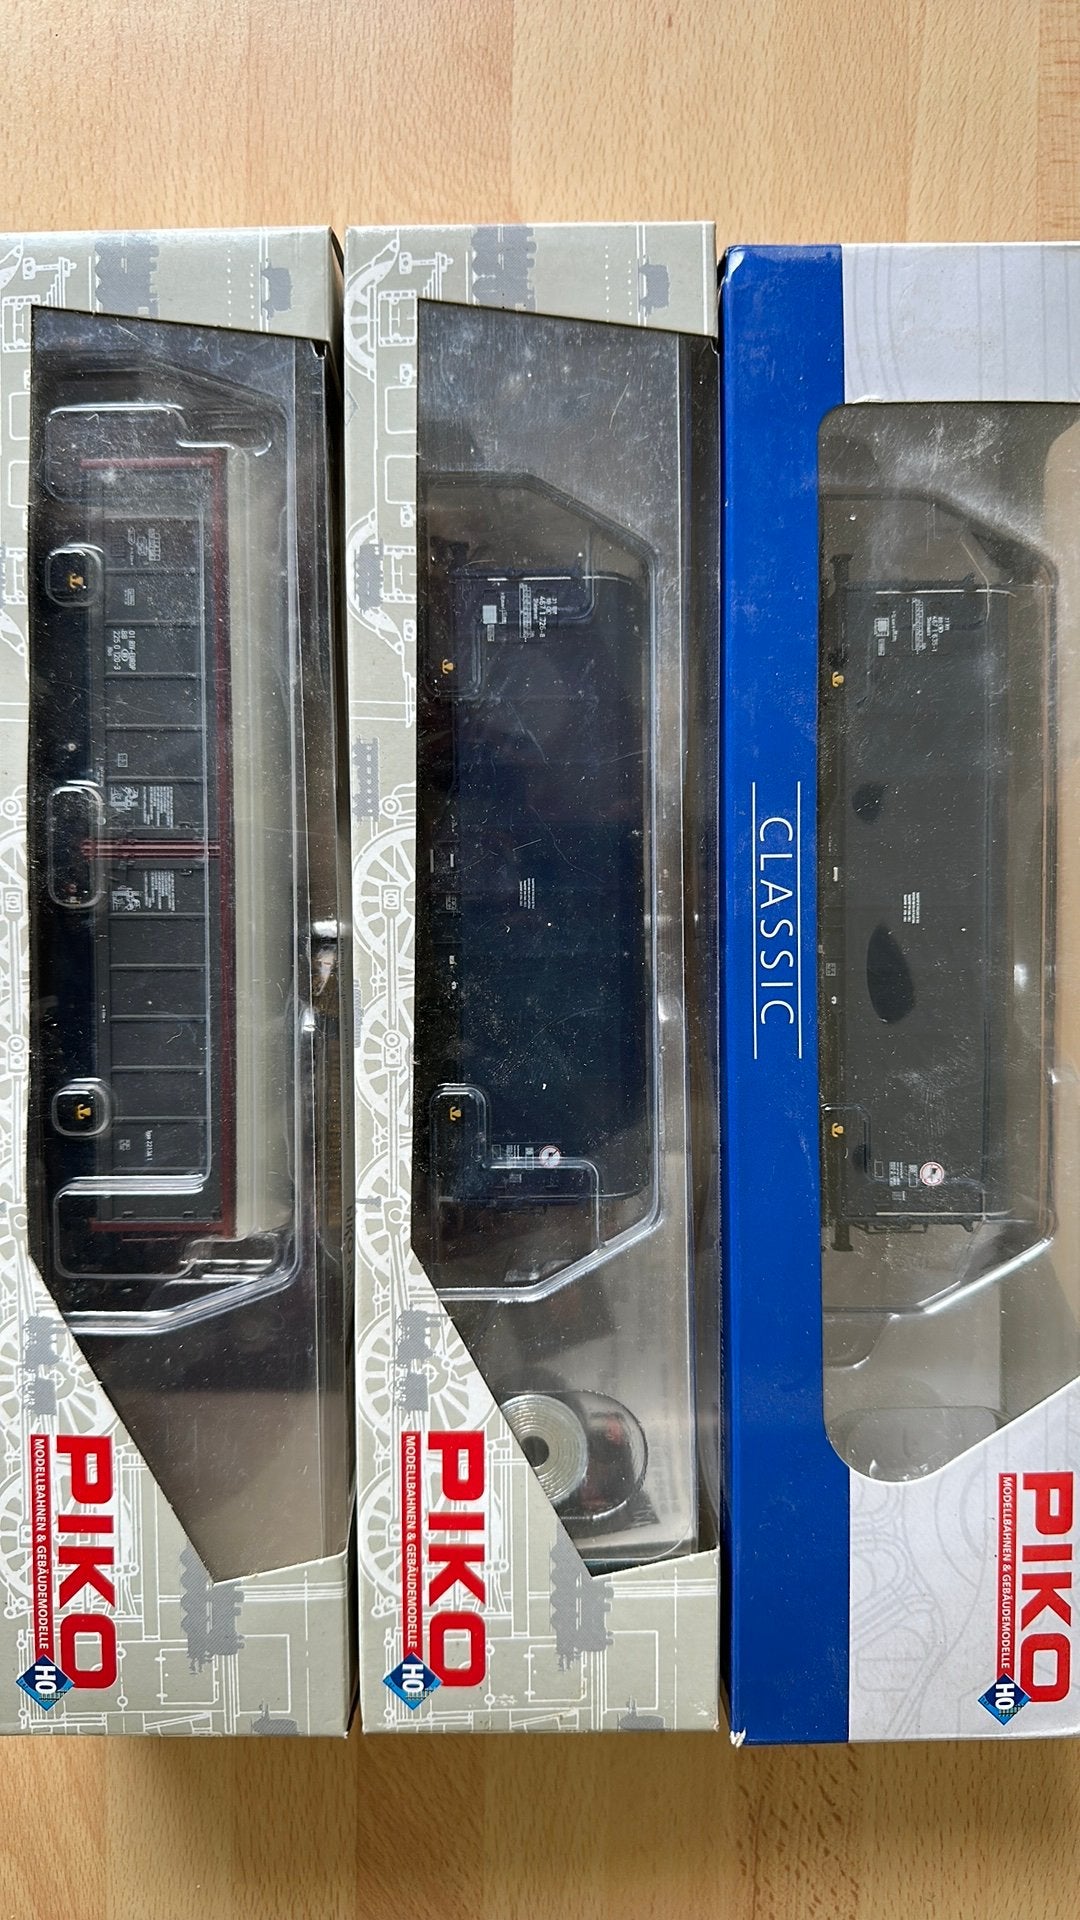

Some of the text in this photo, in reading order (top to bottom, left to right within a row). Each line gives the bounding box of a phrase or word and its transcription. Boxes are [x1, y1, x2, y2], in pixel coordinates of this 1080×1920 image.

[113, 630, 121, 644] 225
[759, 816, 795, 1025] CLASSIC
[34, 1438, 50, 1649] MODELLBAHNEN & GEBÄUDEMODELLE
[56, 1435, 119, 1690] PIKO
[405, 1435, 420, 1648] MODELLBAHNEN & GEBÄUDEMODELLE
[427, 1430, 486, 1687] PIKO
[1001, 1476, 1014, 1669] MODELLBAHNEN & GEBÄUDEMODELLE
[1020, 1472, 1074, 1703] PIKO
